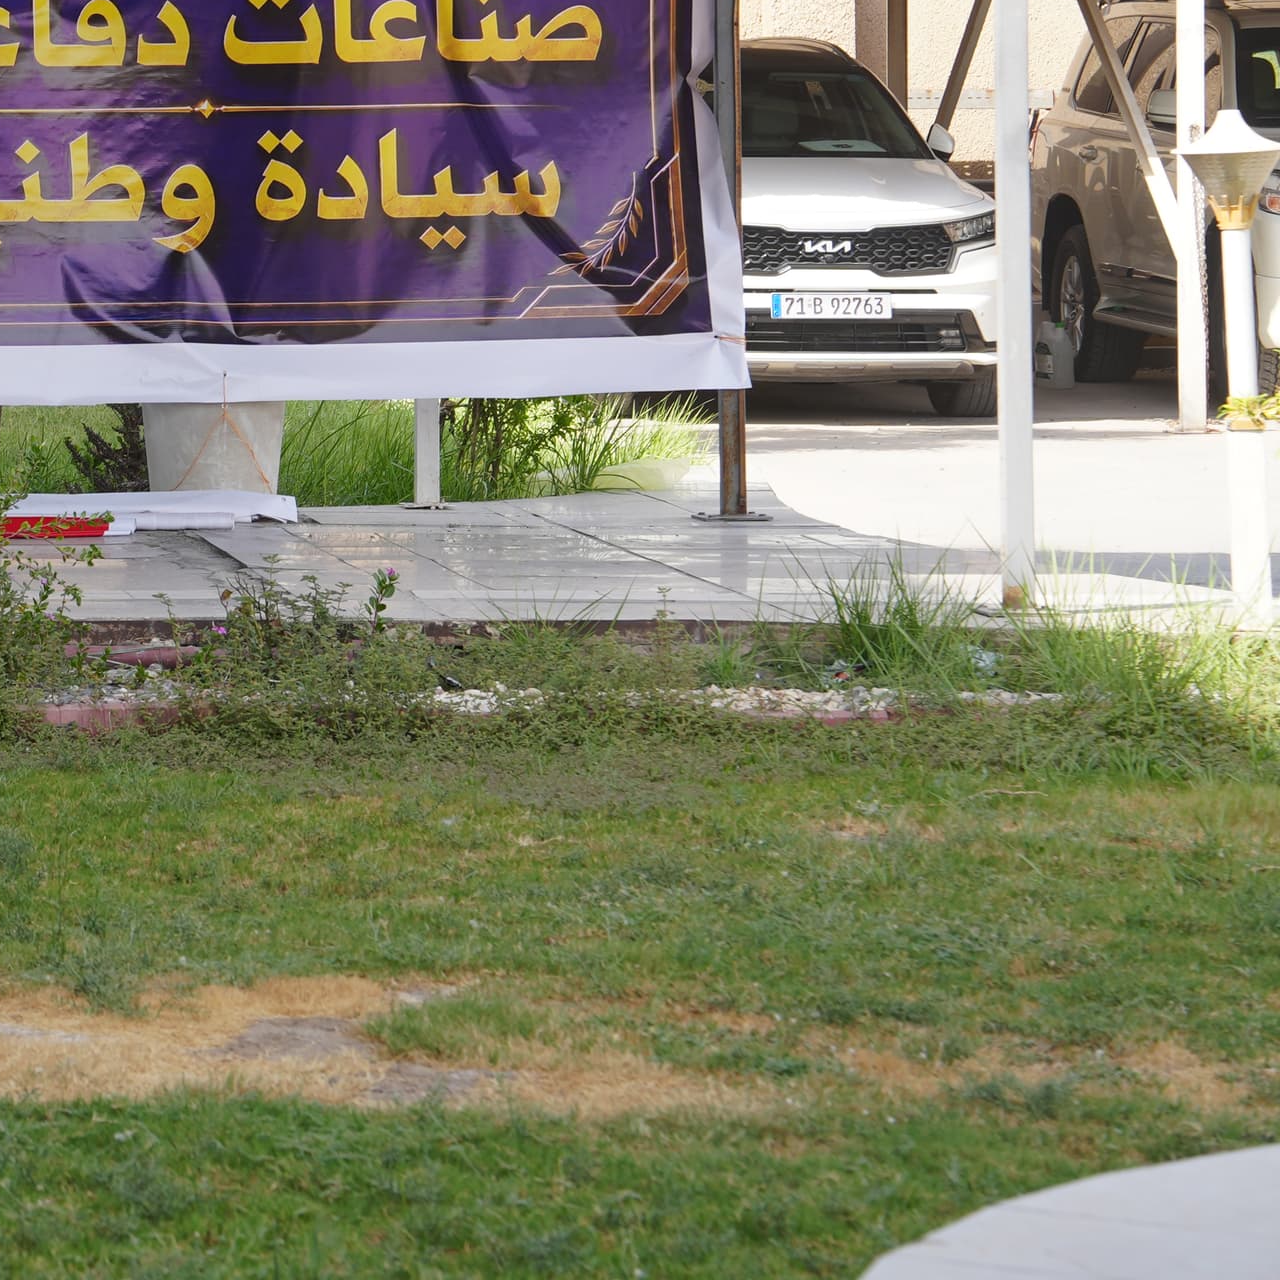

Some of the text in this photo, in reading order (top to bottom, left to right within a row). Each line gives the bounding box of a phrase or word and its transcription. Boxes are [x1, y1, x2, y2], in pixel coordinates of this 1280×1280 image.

[254, 127, 561, 250] سيادة
[784, 296, 806, 315] 71
[813, 297, 823, 315] B
[831, 297, 883, 315] 92763
